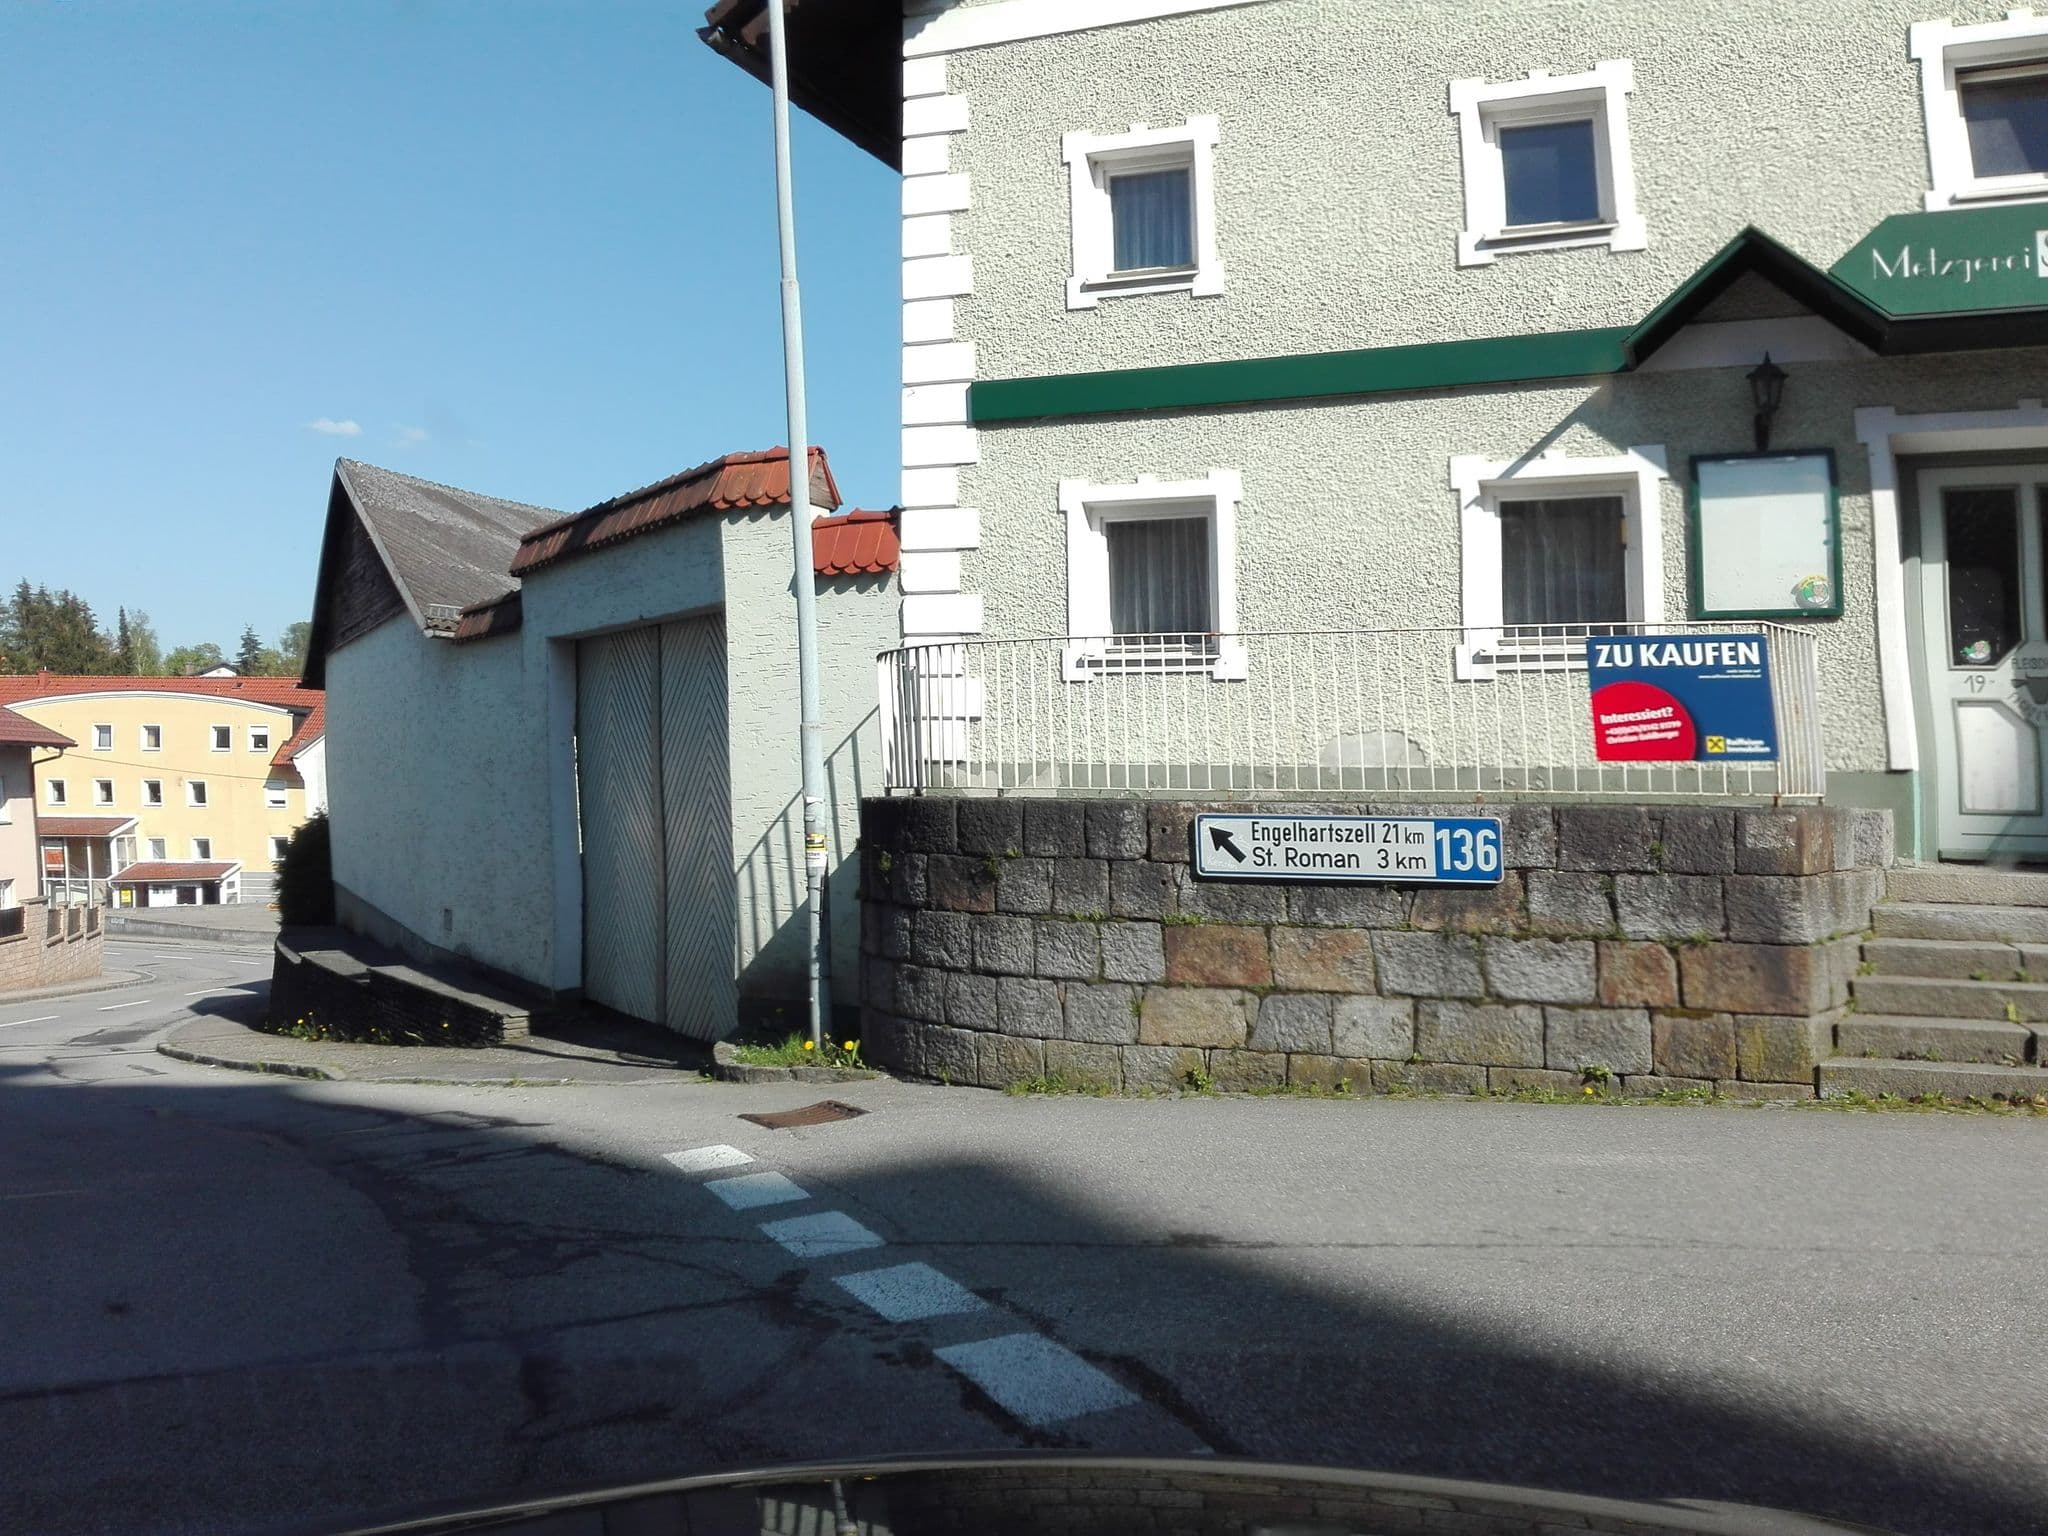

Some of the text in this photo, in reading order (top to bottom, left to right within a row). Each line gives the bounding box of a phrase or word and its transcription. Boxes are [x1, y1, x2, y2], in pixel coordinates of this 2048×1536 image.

[1872, 245, 2030, 283] Metzgerei
[1595, 641, 1761, 668] ZU KAUFEN
[1600, 706, 1673, 725] Interessiert?
[1251, 821, 1425, 845] Engelhartszell 21 km
[1252, 847, 1427, 870] St. Roman 3 km
[1436, 827, 1497, 873] 136
